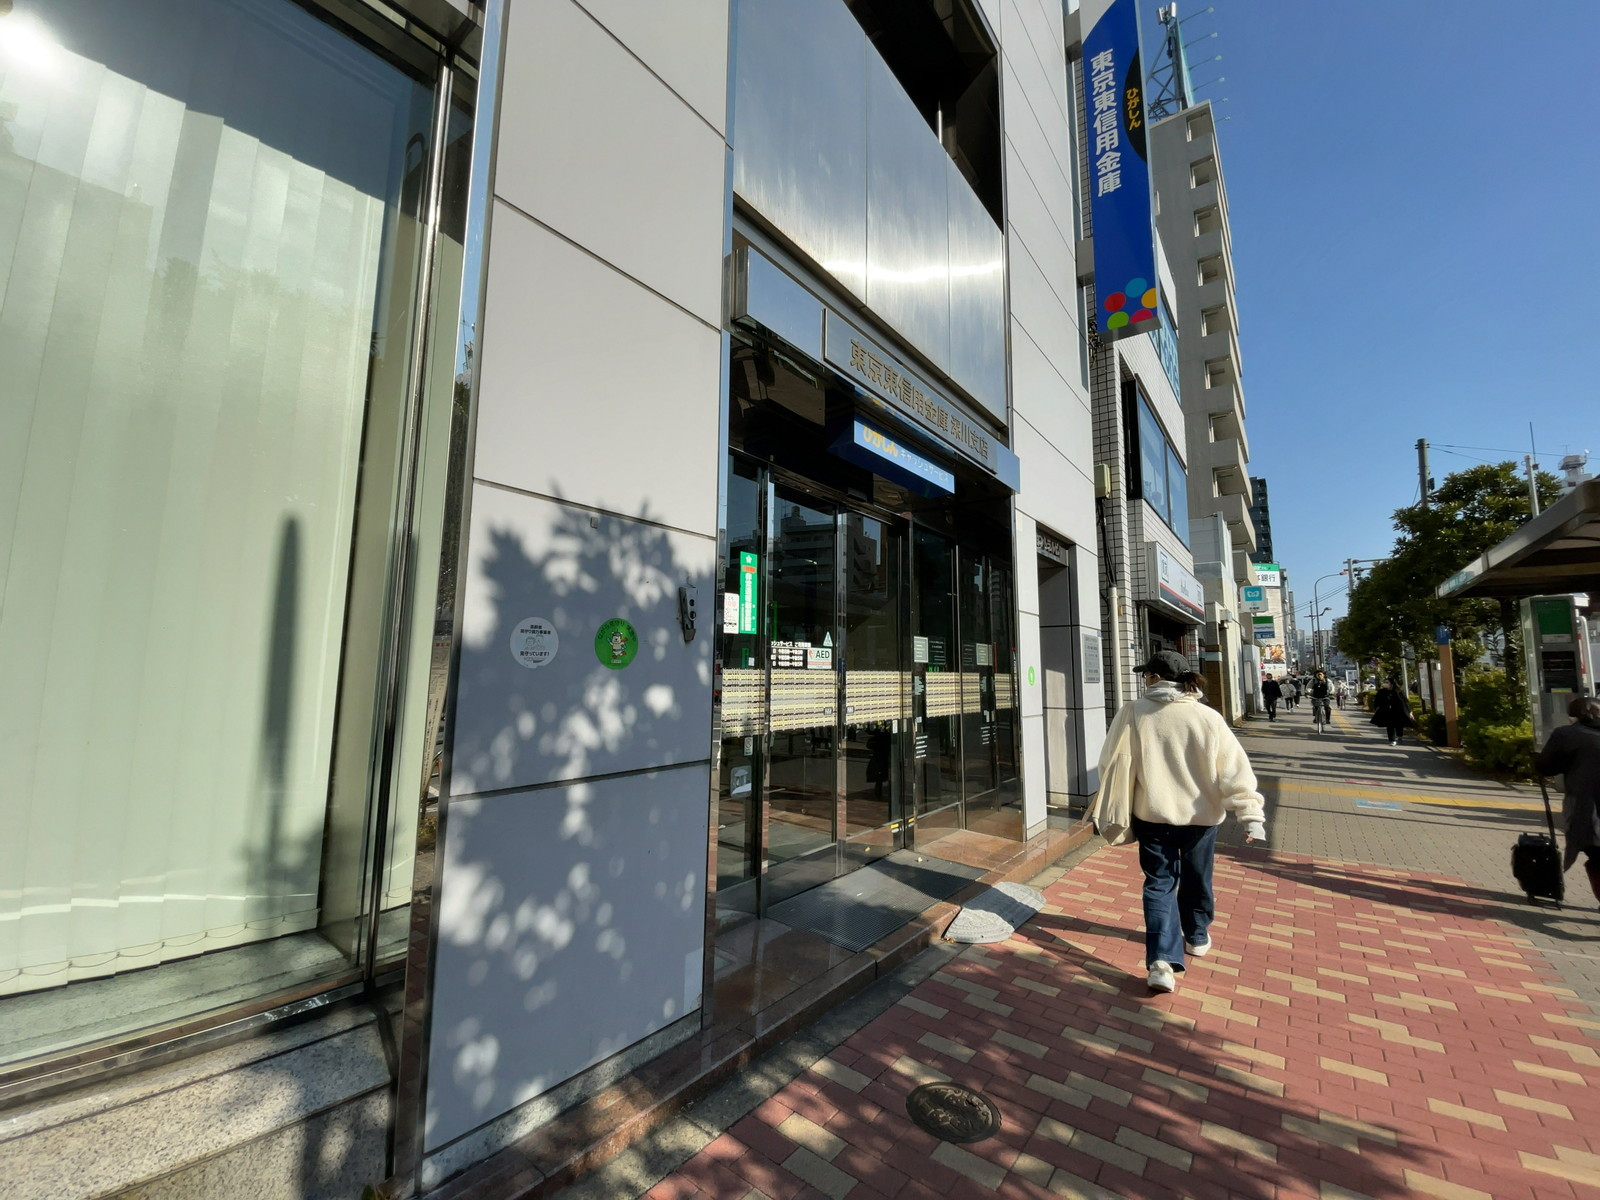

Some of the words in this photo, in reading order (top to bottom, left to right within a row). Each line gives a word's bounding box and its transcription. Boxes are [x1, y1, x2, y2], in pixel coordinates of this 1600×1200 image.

[1090, 48, 1122, 198] 東京東信用金庫
[1126, 87, 1142, 131] ひがしん
[850, 339, 949, 433] 東京東信用金庫
[951, 416, 988, 460] 深川支店
[863, 425, 899, 458] ひがしん
[815, 650, 830, 659] AED
